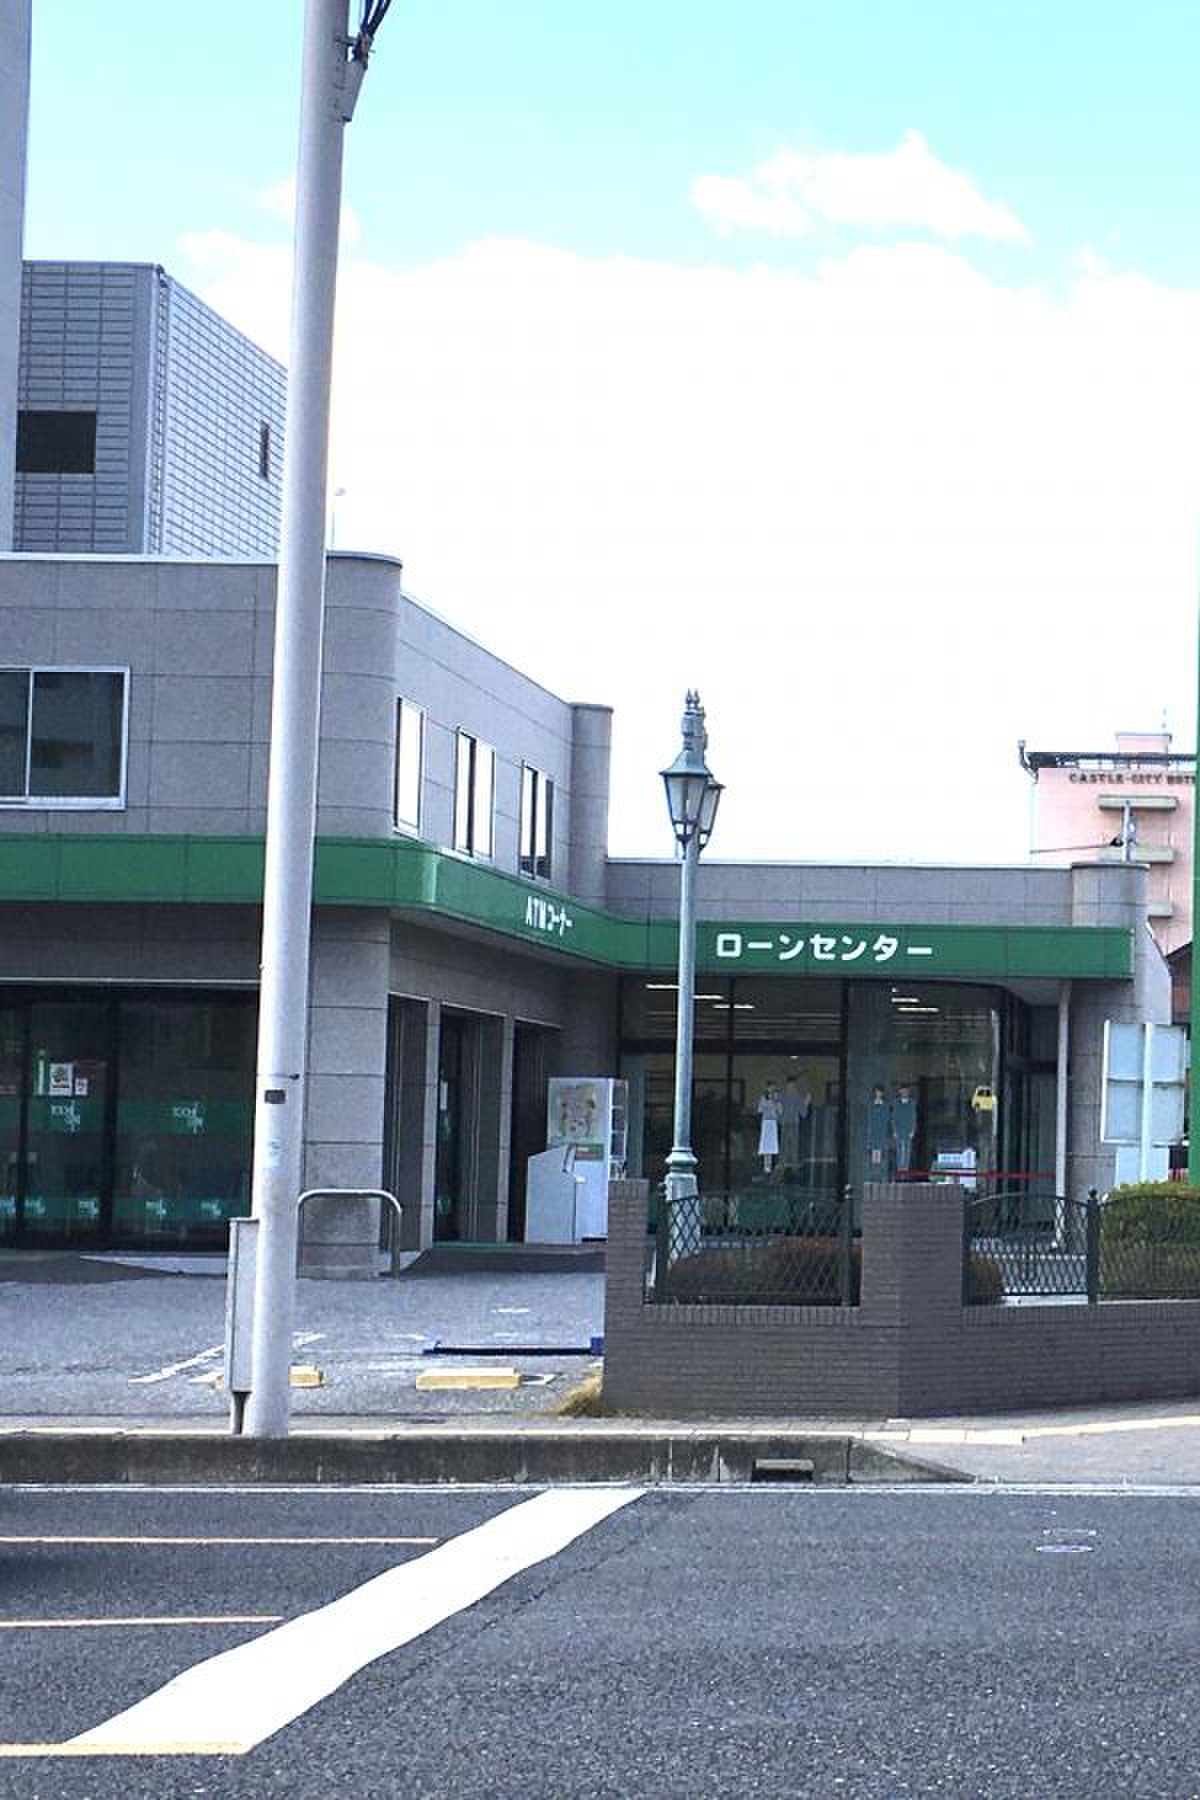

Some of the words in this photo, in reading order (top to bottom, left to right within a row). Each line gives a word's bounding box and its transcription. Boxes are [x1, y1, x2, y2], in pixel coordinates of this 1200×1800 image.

[716, 933, 933, 961] ローンセンター
